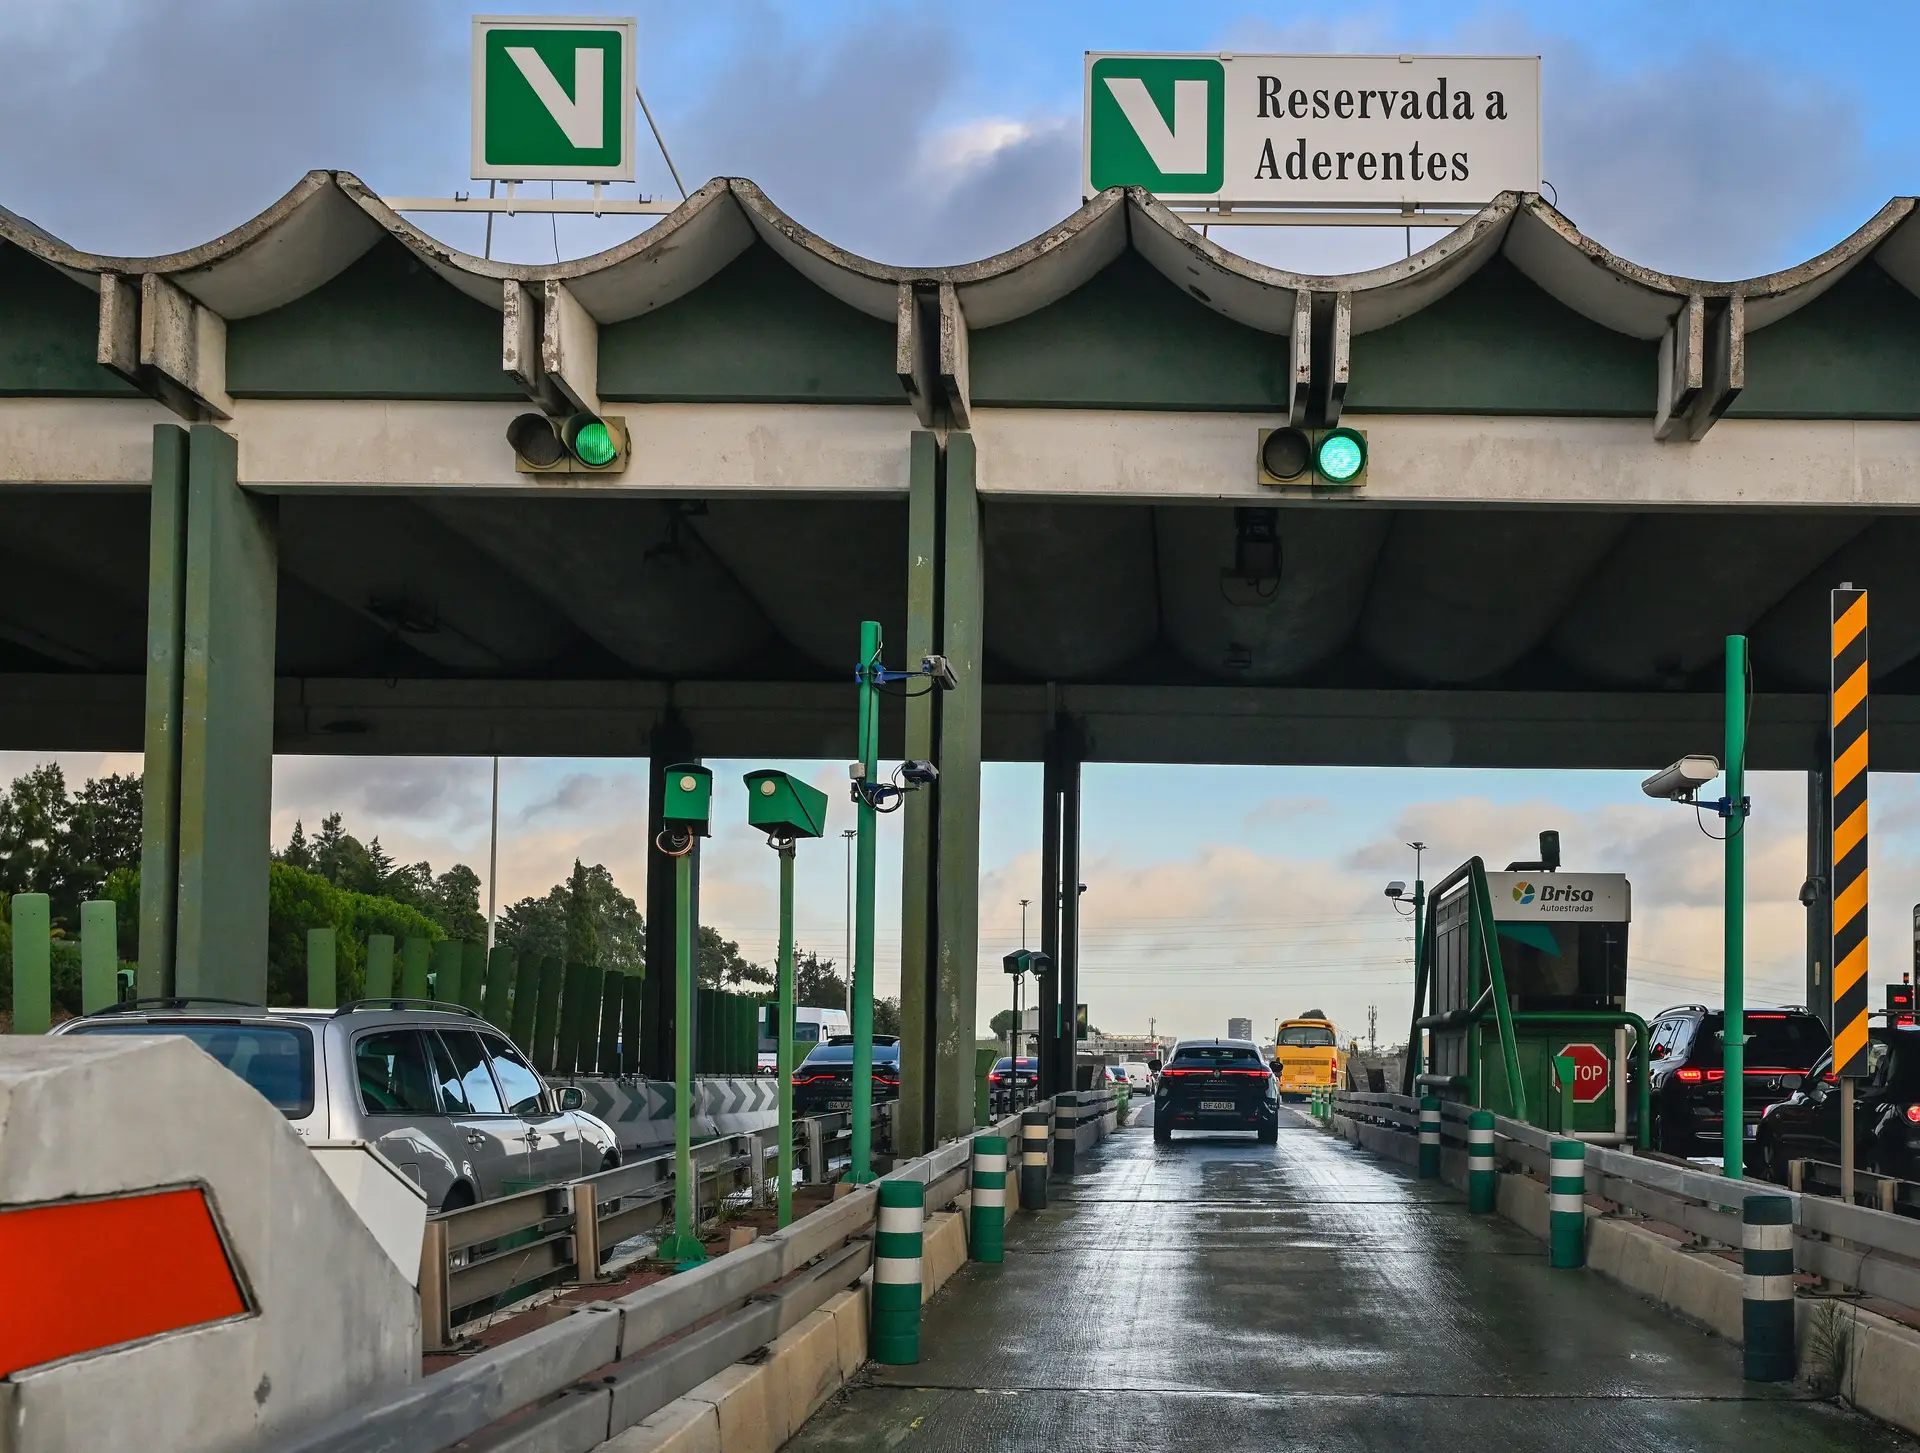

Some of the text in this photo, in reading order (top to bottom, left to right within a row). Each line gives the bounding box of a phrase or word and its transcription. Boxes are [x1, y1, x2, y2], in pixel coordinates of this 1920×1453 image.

[1256, 75, 1508, 121] Reservada a
[1254, 137, 1470, 182] Aderentes
[1540, 884, 1594, 902] Brisa
[1540, 904, 1594, 913] Autoestradas
[1573, 1065, 1603, 1081] TOP
